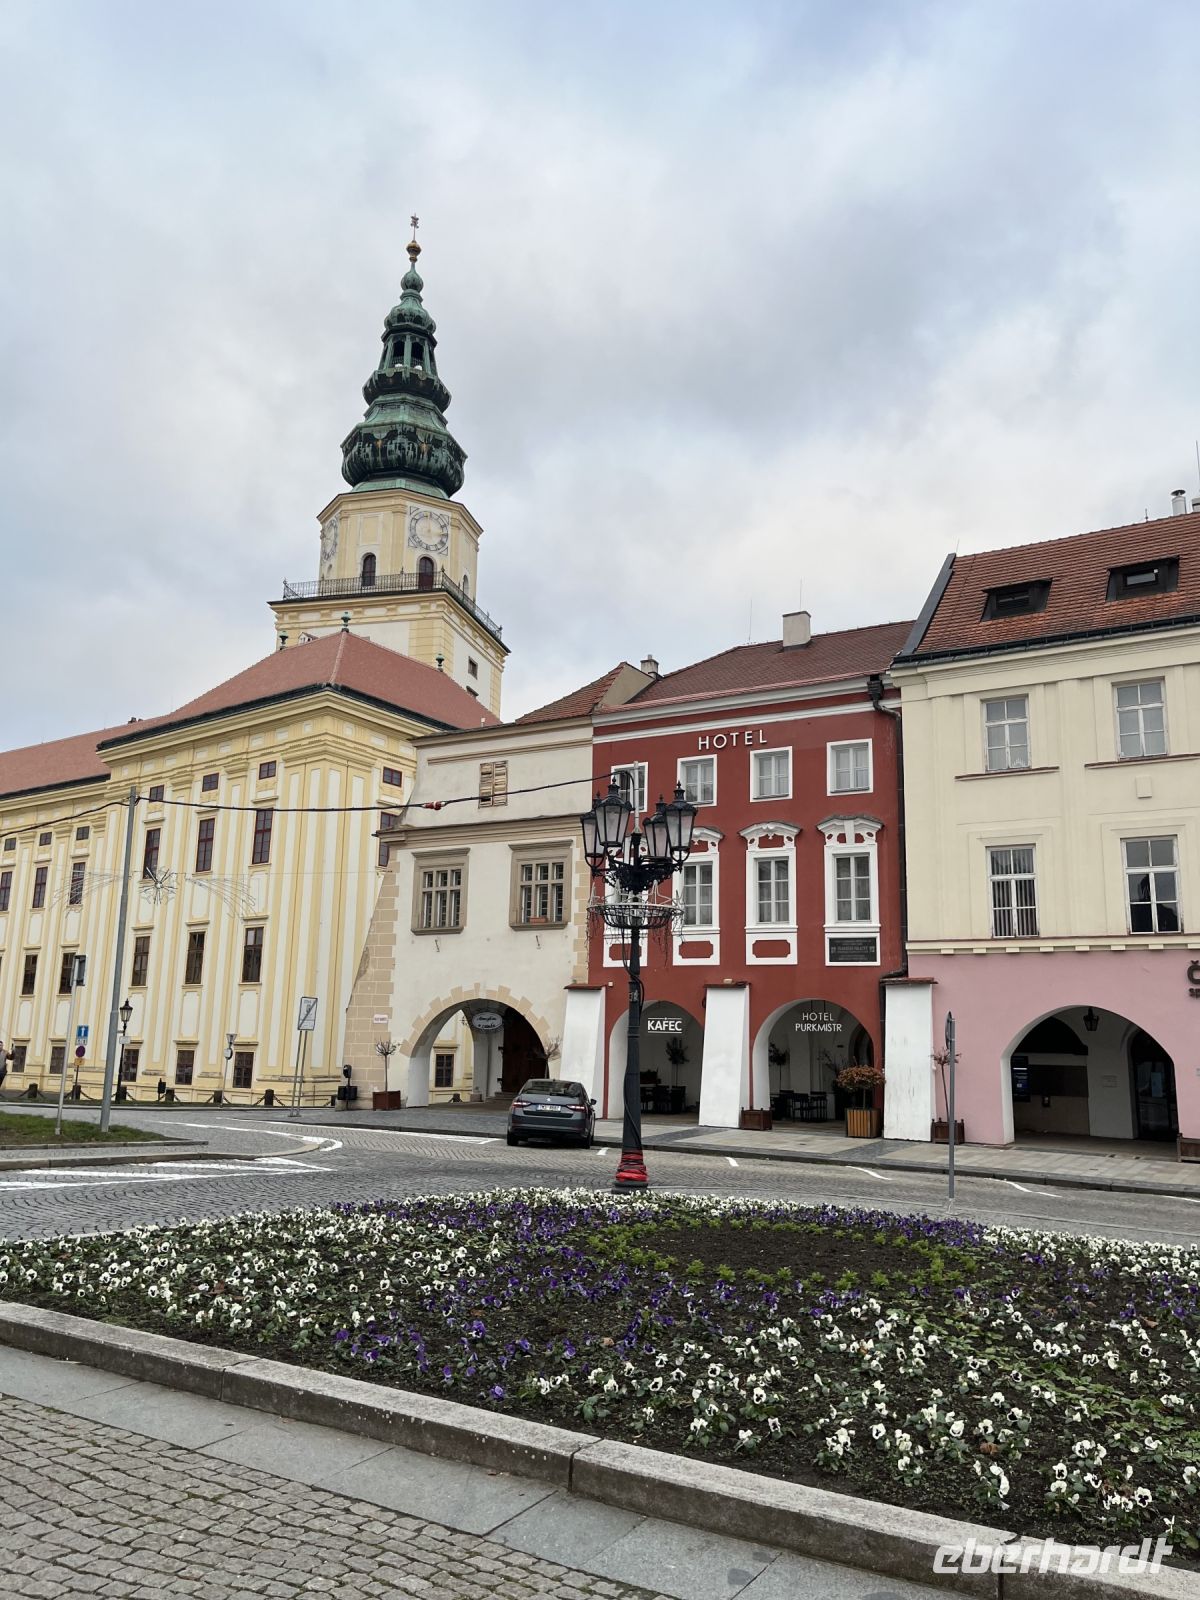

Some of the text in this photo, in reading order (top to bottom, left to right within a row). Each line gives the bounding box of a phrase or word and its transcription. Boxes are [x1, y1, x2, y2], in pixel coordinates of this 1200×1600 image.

[698, 729, 768, 751] HOTEL
[802, 1012, 834, 1021] HOTEL
[647, 1020, 682, 1031] KAFEC
[795, 1023, 842, 1032] PURKMISTR
